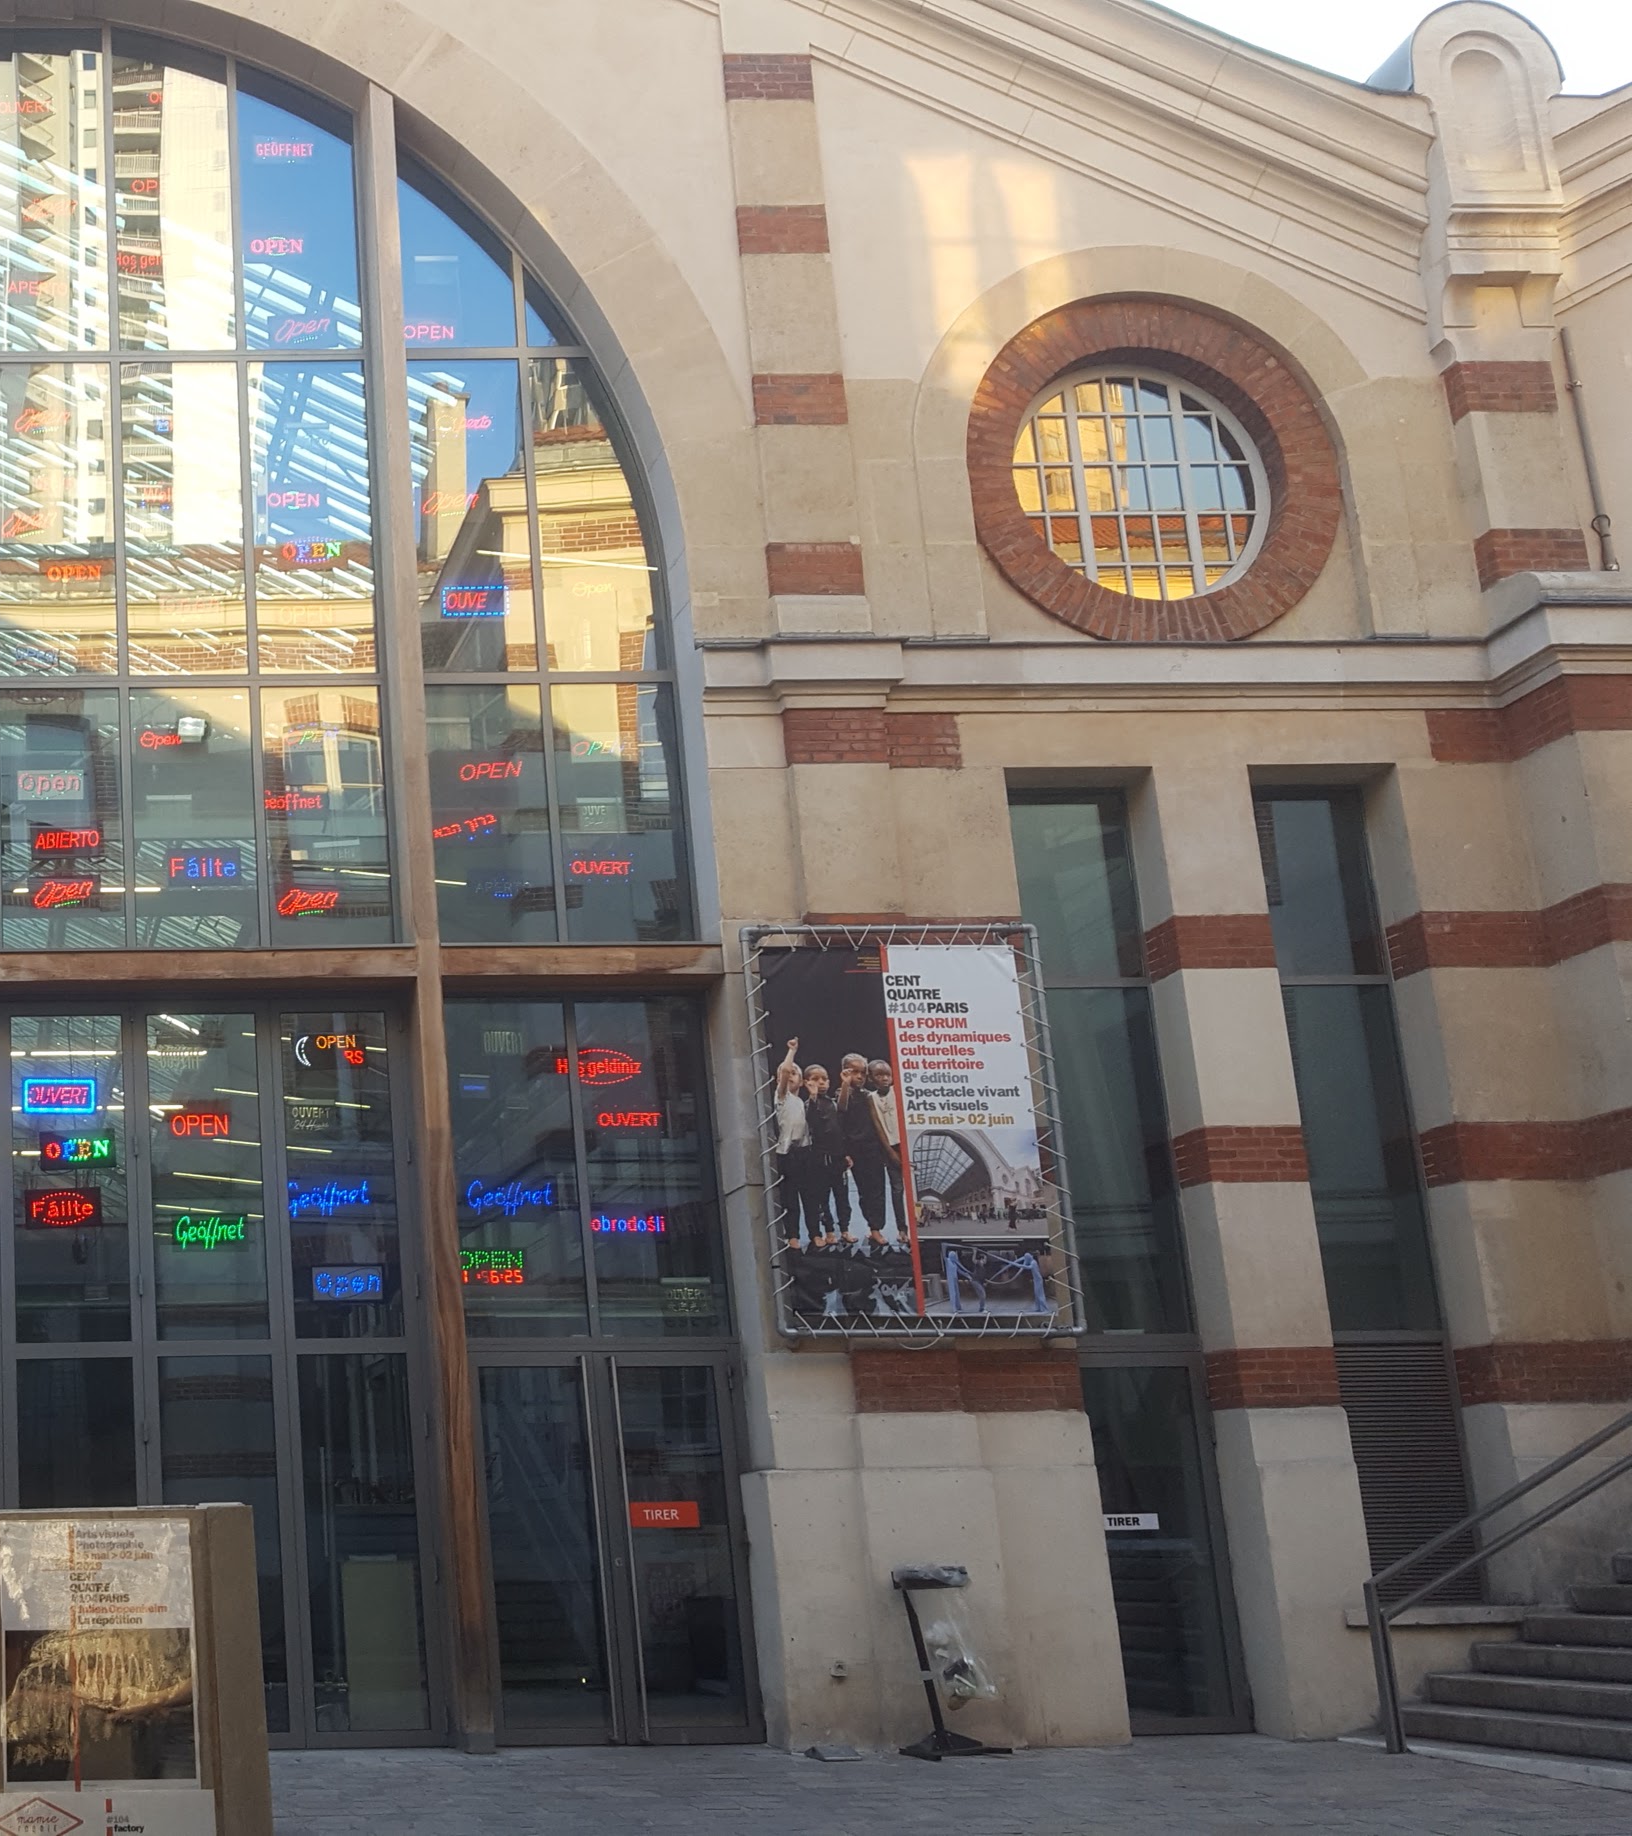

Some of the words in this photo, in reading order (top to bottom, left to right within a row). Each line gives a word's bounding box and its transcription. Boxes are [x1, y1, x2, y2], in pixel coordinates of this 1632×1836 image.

[256, 141, 314, 157] GEÖFFNET
[250, 238, 304, 254] OPEN
[275, 316, 331, 343] Open
[404, 325, 454, 340] OPEN
[268, 492, 320, 508] OPEN
[422, 491, 480, 516] Open
[282, 541, 342, 561] OPEN
[47, 564, 102, 582] OPEN
[279, 606, 334, 624] OPEN
[140, 730, 182, 750] Open
[459, 760, 523, 781] OPEN
[18, 772, 81, 795] Open
[34, 830, 100, 849] ABIERTO
[171, 857, 237, 879] Fáilte
[570, 860, 632, 875] OUVERT
[34, 880, 94, 908] Open
[277, 889, 339, 915] Open
[885, 975, 921, 986] CENT
[886, 989, 941, 1001] QUATRE
[898, 1018, 914, 1029] Le
[917, 1017, 968, 1029] FORUM
[316, 1035, 356, 1049] OPEN
[899, 1031, 925, 1042] des
[926, 1031, 1011, 1045] dynamiques
[900, 1045, 975, 1056] culturelles
[902, 1059, 919, 1070] du
[921, 1058, 985, 1069] territoire
[920, 1071, 969, 1083] édition
[905, 1086, 975, 1099] Spectacle
[979, 1086, 1020, 1097] vivant
[906, 1100, 936, 1111] Arts
[940, 1099, 989, 1111] visuels
[172, 1114, 229, 1137] OPEN
[597, 1112, 662, 1127] OUVERT
[908, 1114, 925, 1125] 15
[928, 1113, 954, 1124] mai
[968, 1113, 986, 1124] 02
[988, 1113, 1014, 1127] juin
[45, 1138, 111, 1160] OPEN
[468, 1180, 552, 1216] Geöffnet
[32, 1200, 95, 1219] Fáilte
[176, 1216, 245, 1249] Geöffnet
[459, 1250, 523, 1269] OPEN
[315, 1271, 382, 1297] Open
[643, 1509, 679, 1520] TIRER
[1107, 1517, 1141, 1526] TIRER
[106, 1816, 130, 1824] #104
[113, 1825, 144, 1833] factory
